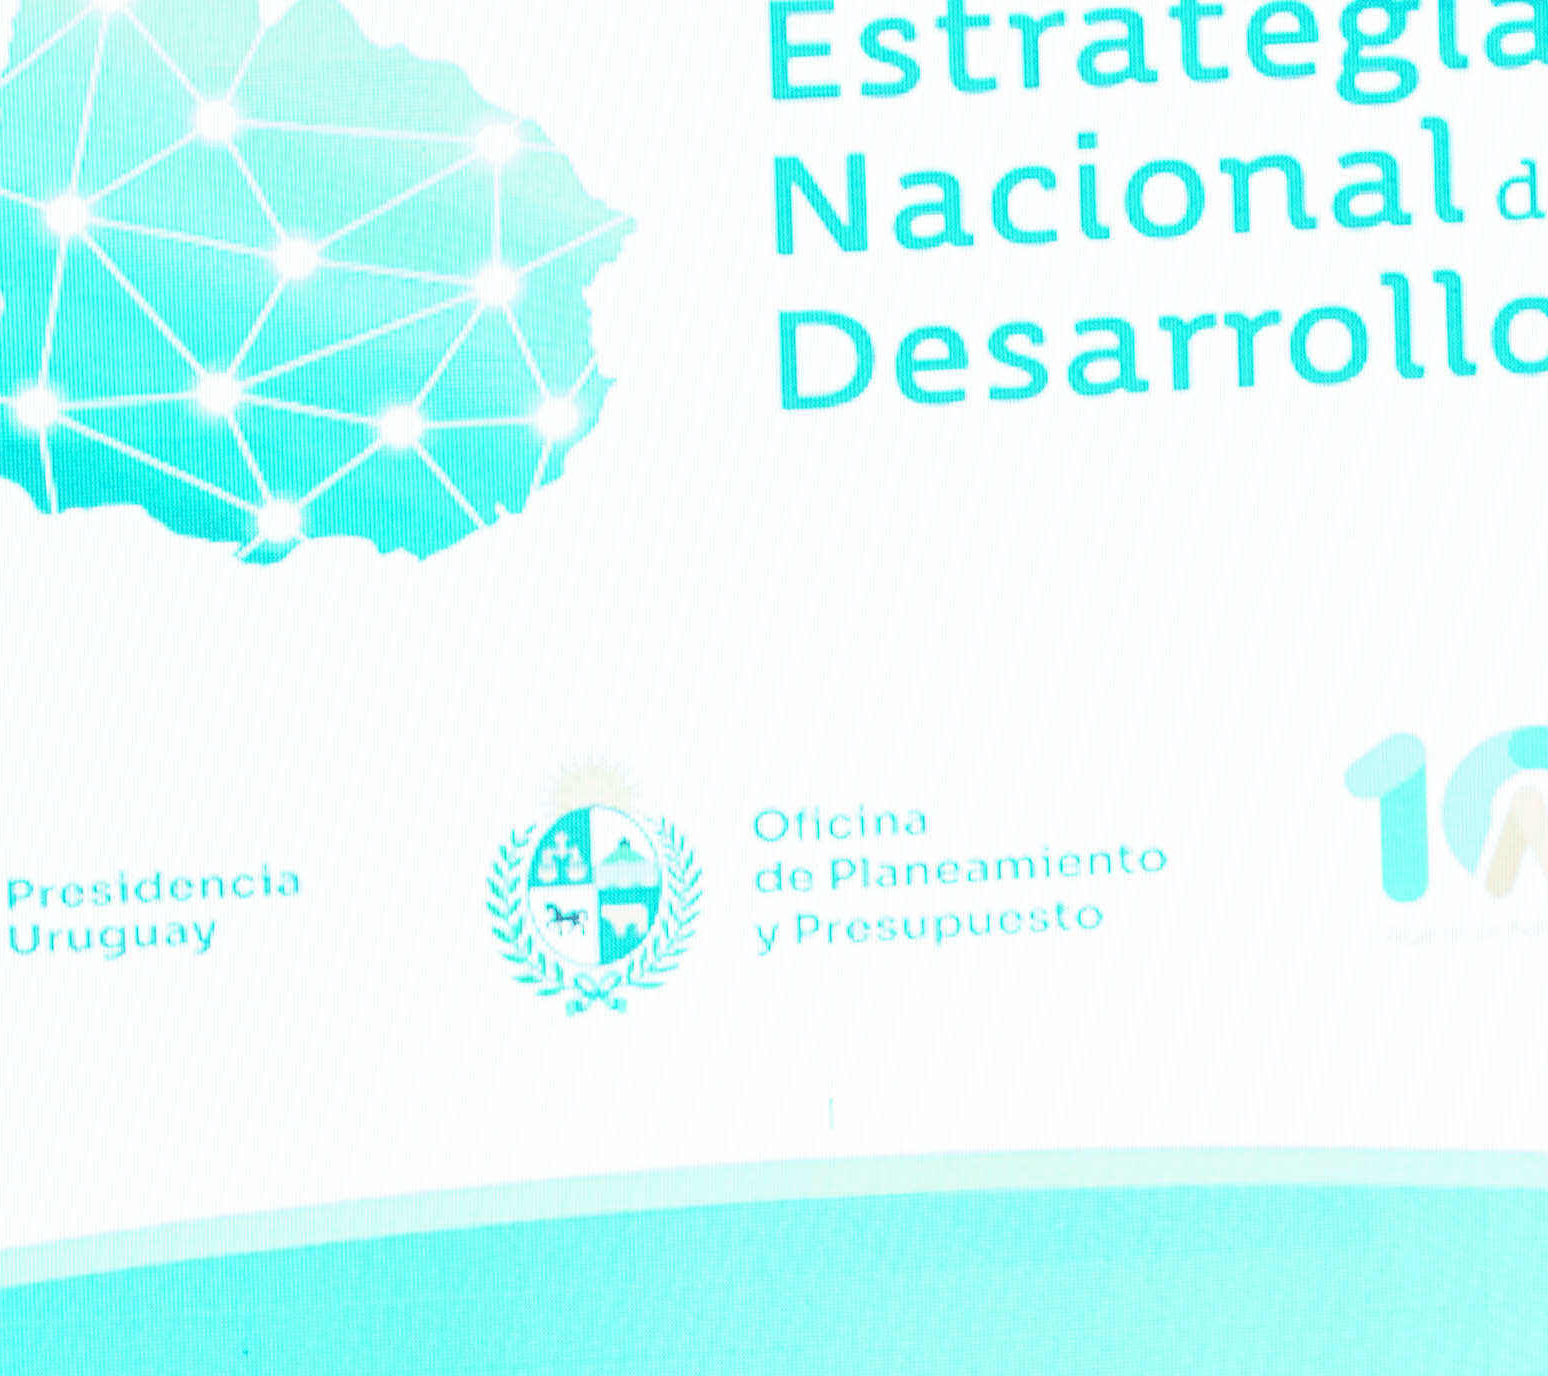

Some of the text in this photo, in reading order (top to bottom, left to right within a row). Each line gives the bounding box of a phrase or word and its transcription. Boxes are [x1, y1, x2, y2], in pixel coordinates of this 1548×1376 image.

[773, 116, 1466, 256] Nacional
[753, 803, 928, 844] Oficina
[7, 863, 302, 911] Presidencia
[755, 844, 1169, 895] de Planeamiento
[8, 918, 218, 961] Uruguay
[755, 902, 1105, 958] y Presupuesto
